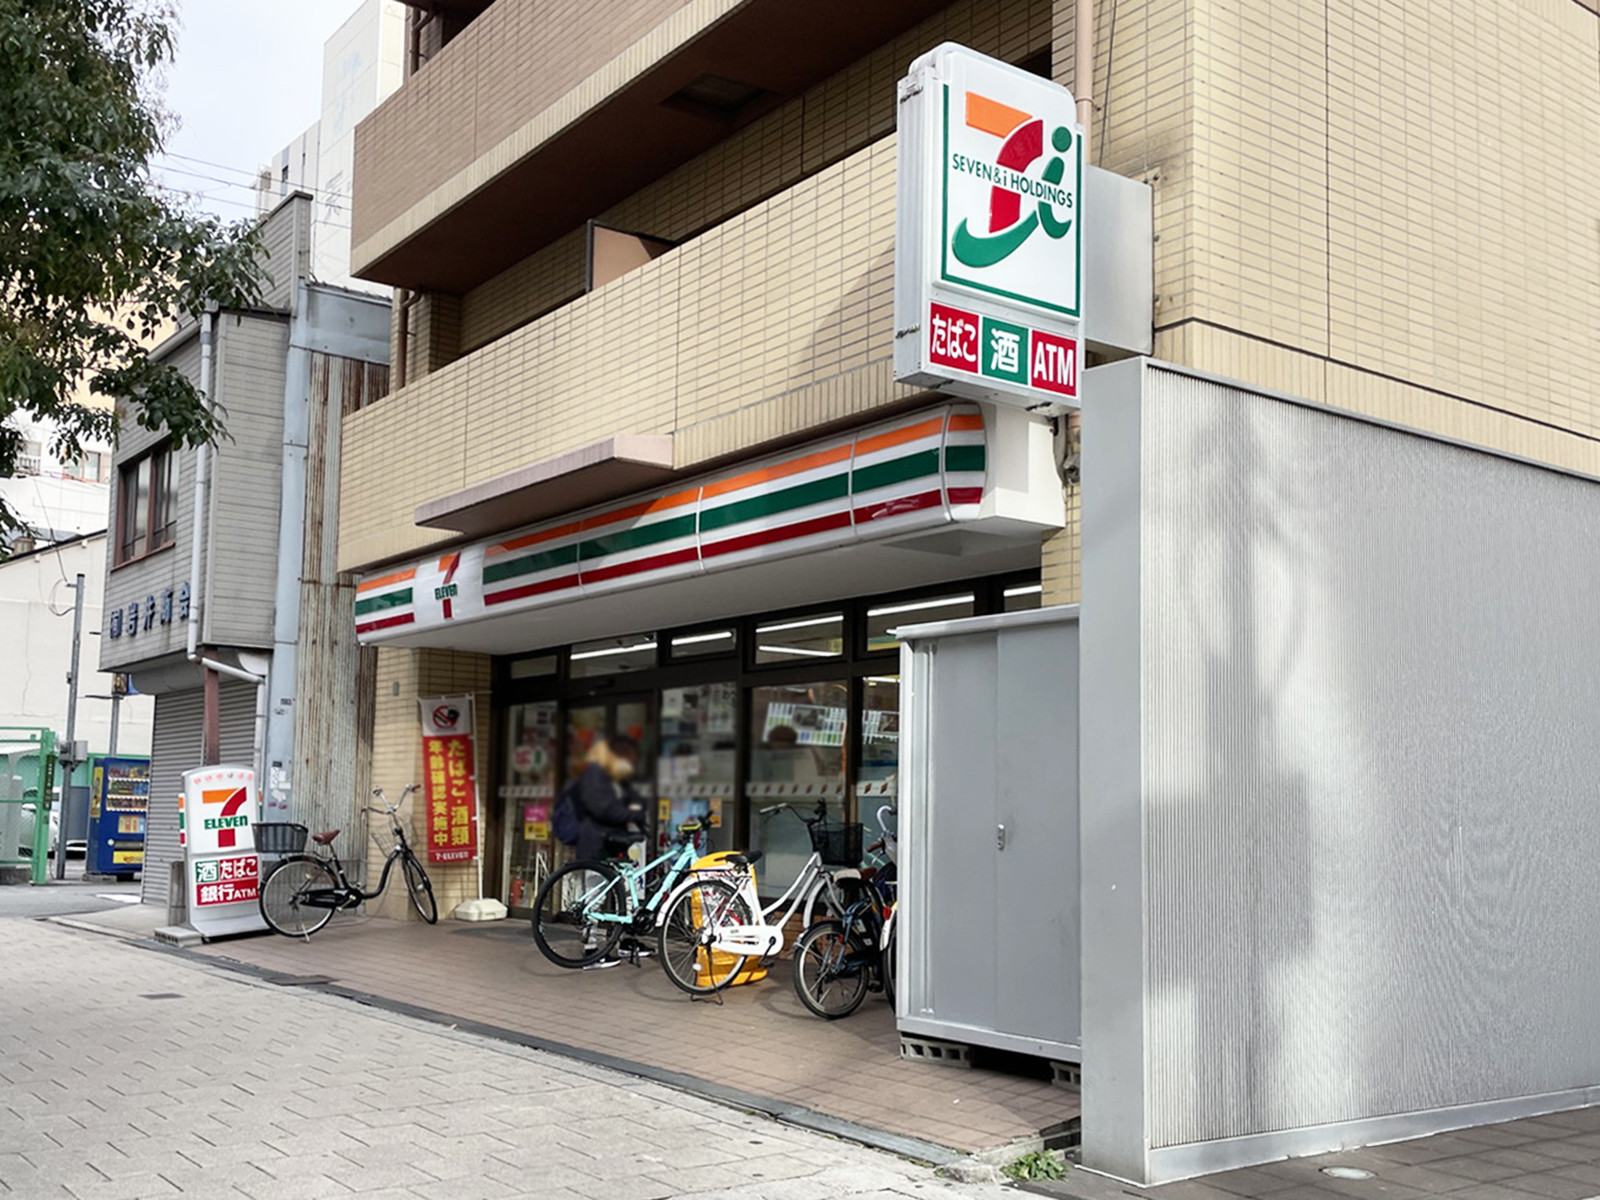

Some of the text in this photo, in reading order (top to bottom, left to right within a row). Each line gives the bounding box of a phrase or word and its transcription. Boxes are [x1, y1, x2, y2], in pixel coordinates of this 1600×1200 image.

[1011, 172, 1073, 209] HOLDINGS
[931, 313, 1075, 387] たばこ 酒 ATM
[201, 786, 248, 849] 7
[197, 858, 258, 882] 酒 たばこ
